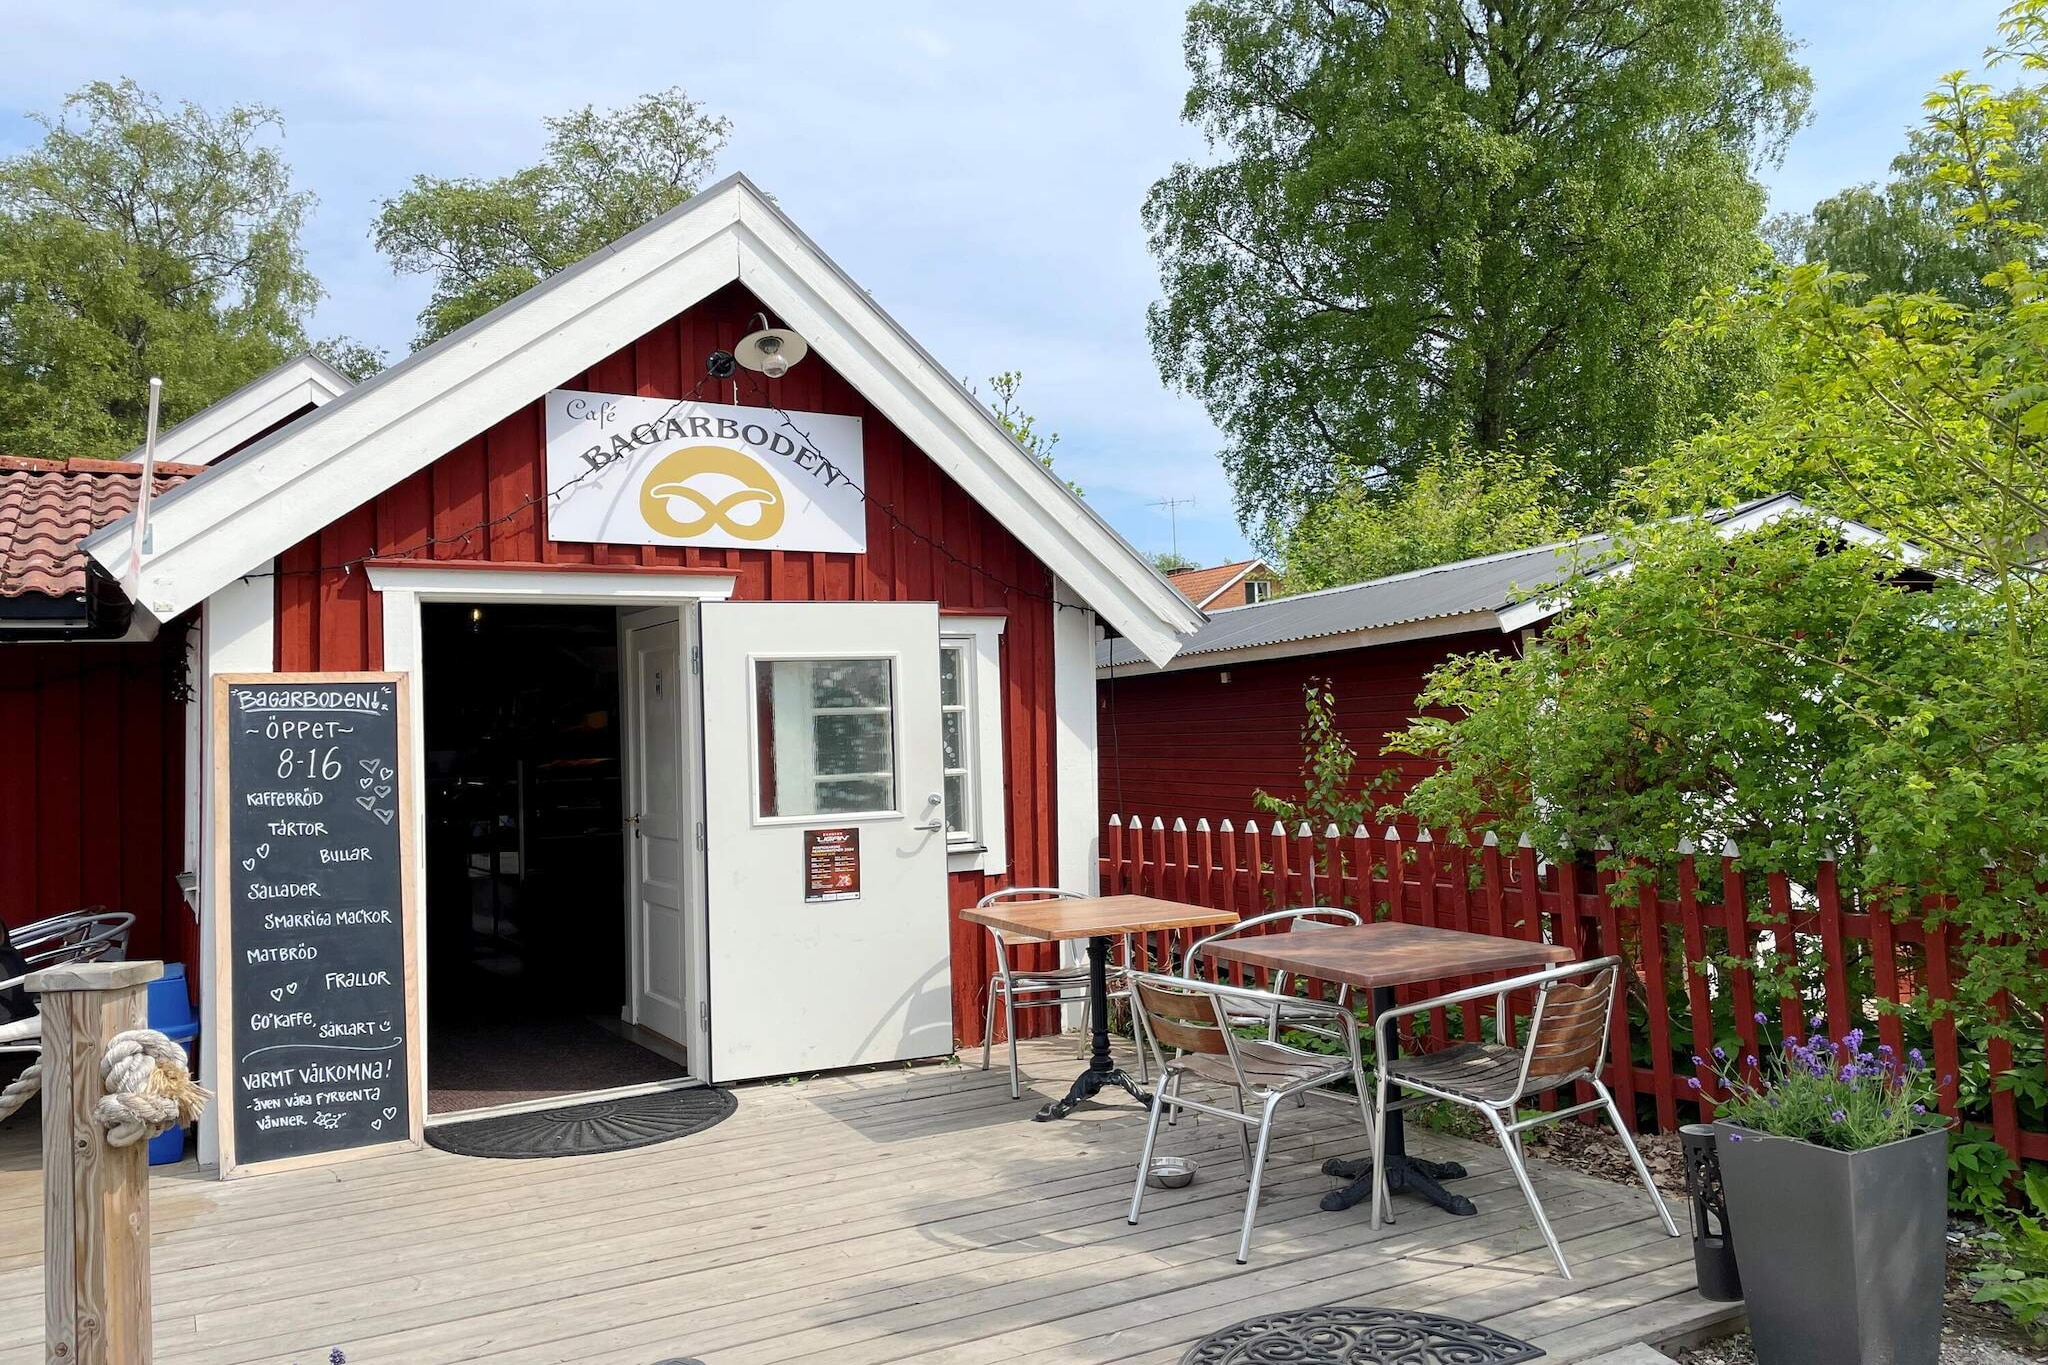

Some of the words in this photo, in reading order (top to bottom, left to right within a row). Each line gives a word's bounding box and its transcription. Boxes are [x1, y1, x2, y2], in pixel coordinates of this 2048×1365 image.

[566, 398, 616, 429] Café
[580, 416, 842, 488] BAGARBODEN
[277, 746, 342, 781] 8-16
